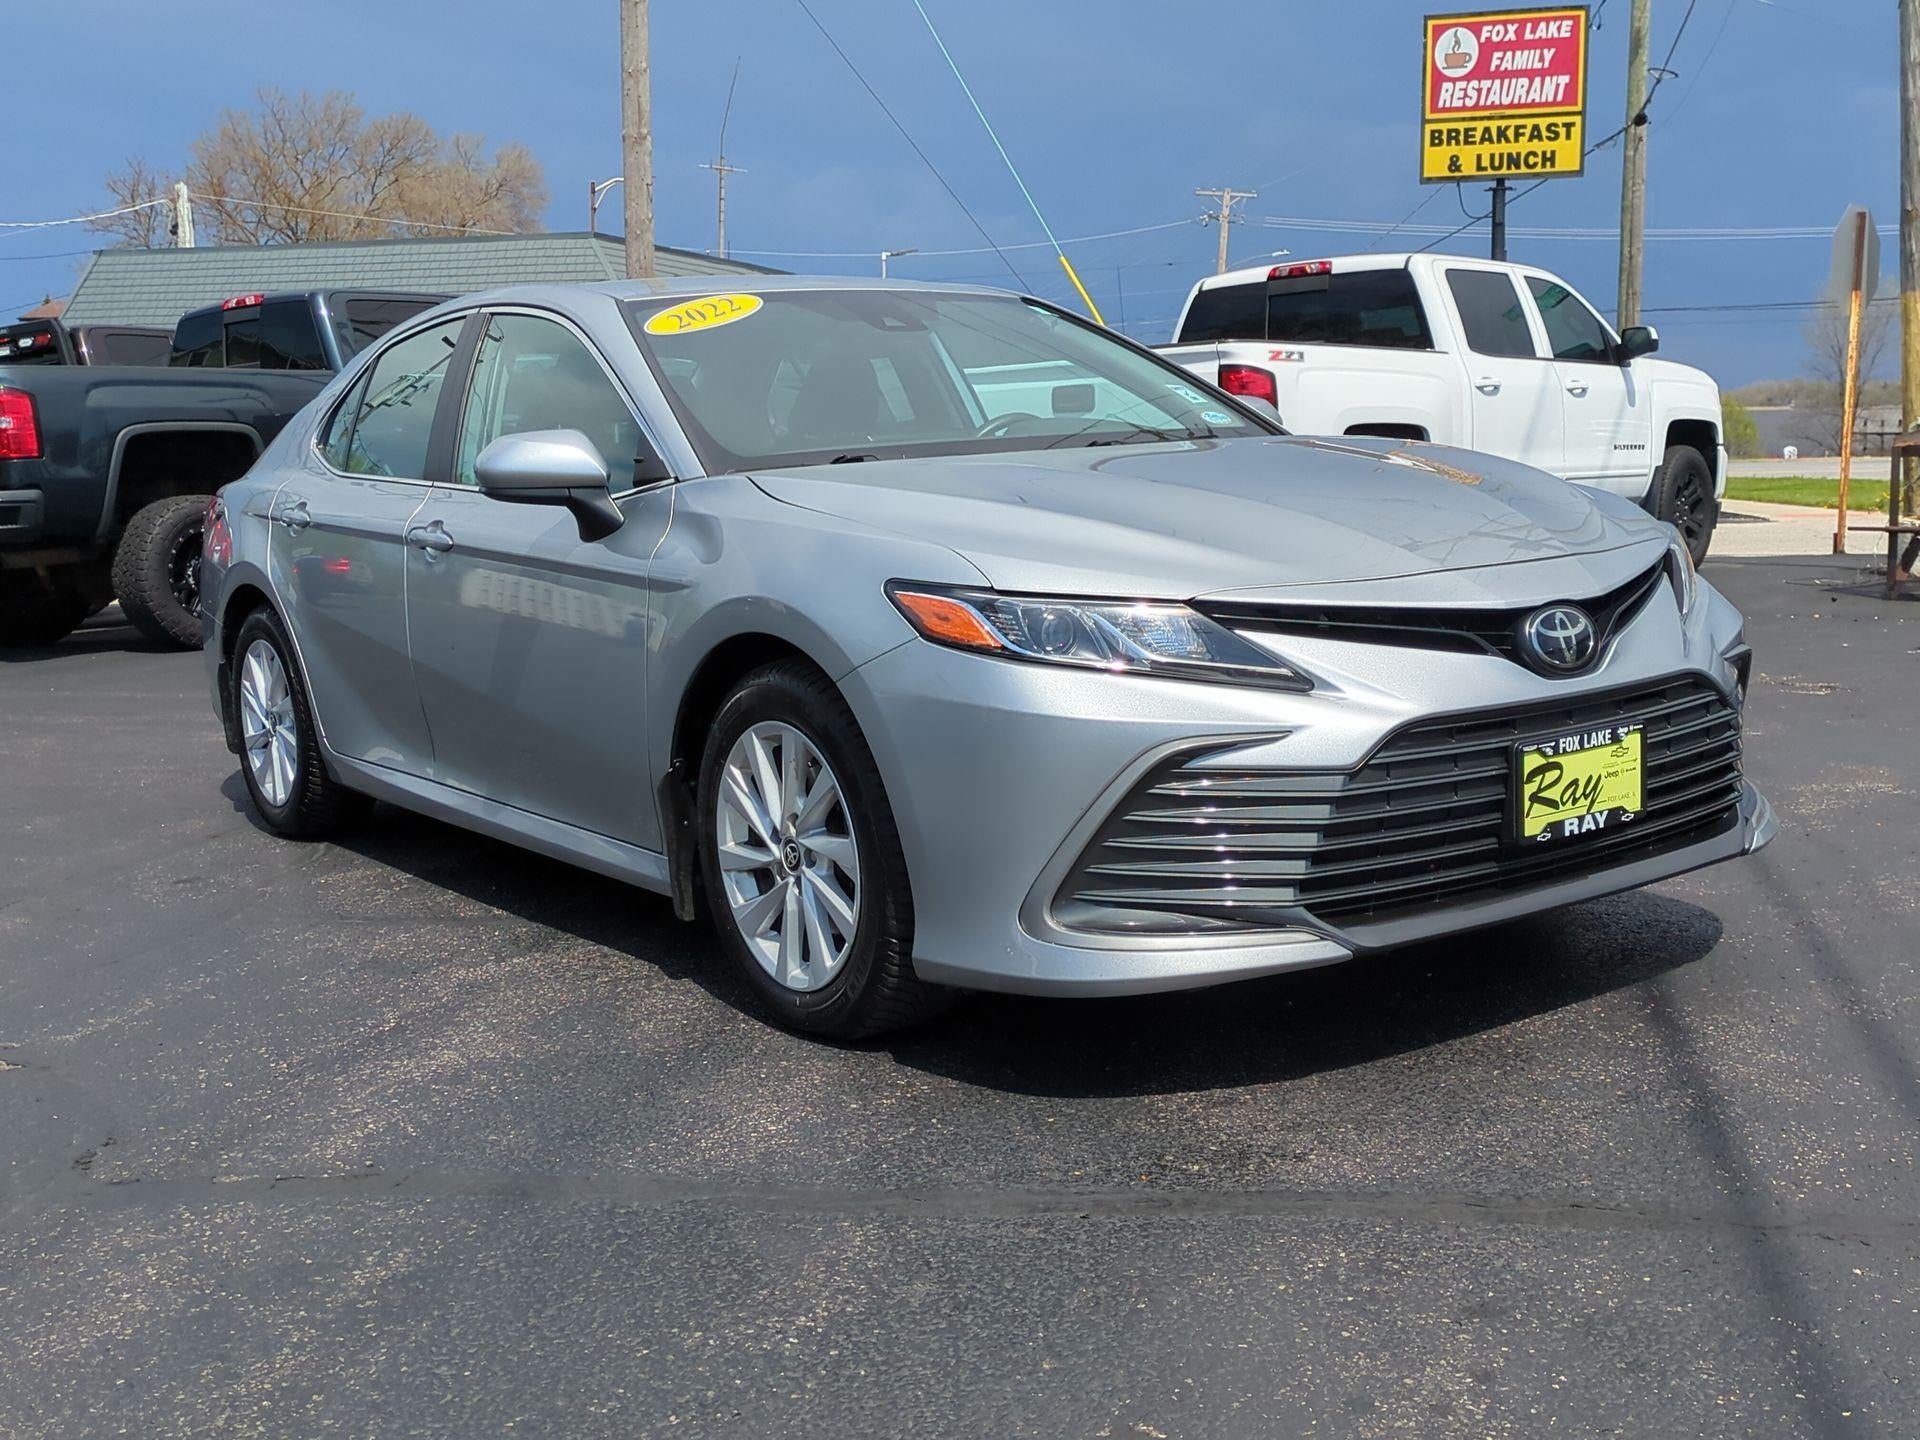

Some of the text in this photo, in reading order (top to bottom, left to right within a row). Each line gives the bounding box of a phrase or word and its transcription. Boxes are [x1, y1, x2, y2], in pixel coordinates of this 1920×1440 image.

[1480, 20, 1573, 43] FOX LAKE
[1490, 48, 1556, 72] FAMILY
[1437, 75, 1570, 109] RESTAURANT
[1429, 122, 1576, 148] BREAKFAST
[1447, 150, 1556, 174] & LUNCH
[666, 298, 742, 329] 2022
[1268, 350, 1305, 362] Z71
[1559, 729, 1612, 754] FOX LAKE
[1604, 770, 1619, 779] Jeep
[1523, 761, 1604, 819] Ray
[1564, 810, 1609, 837] RAY
